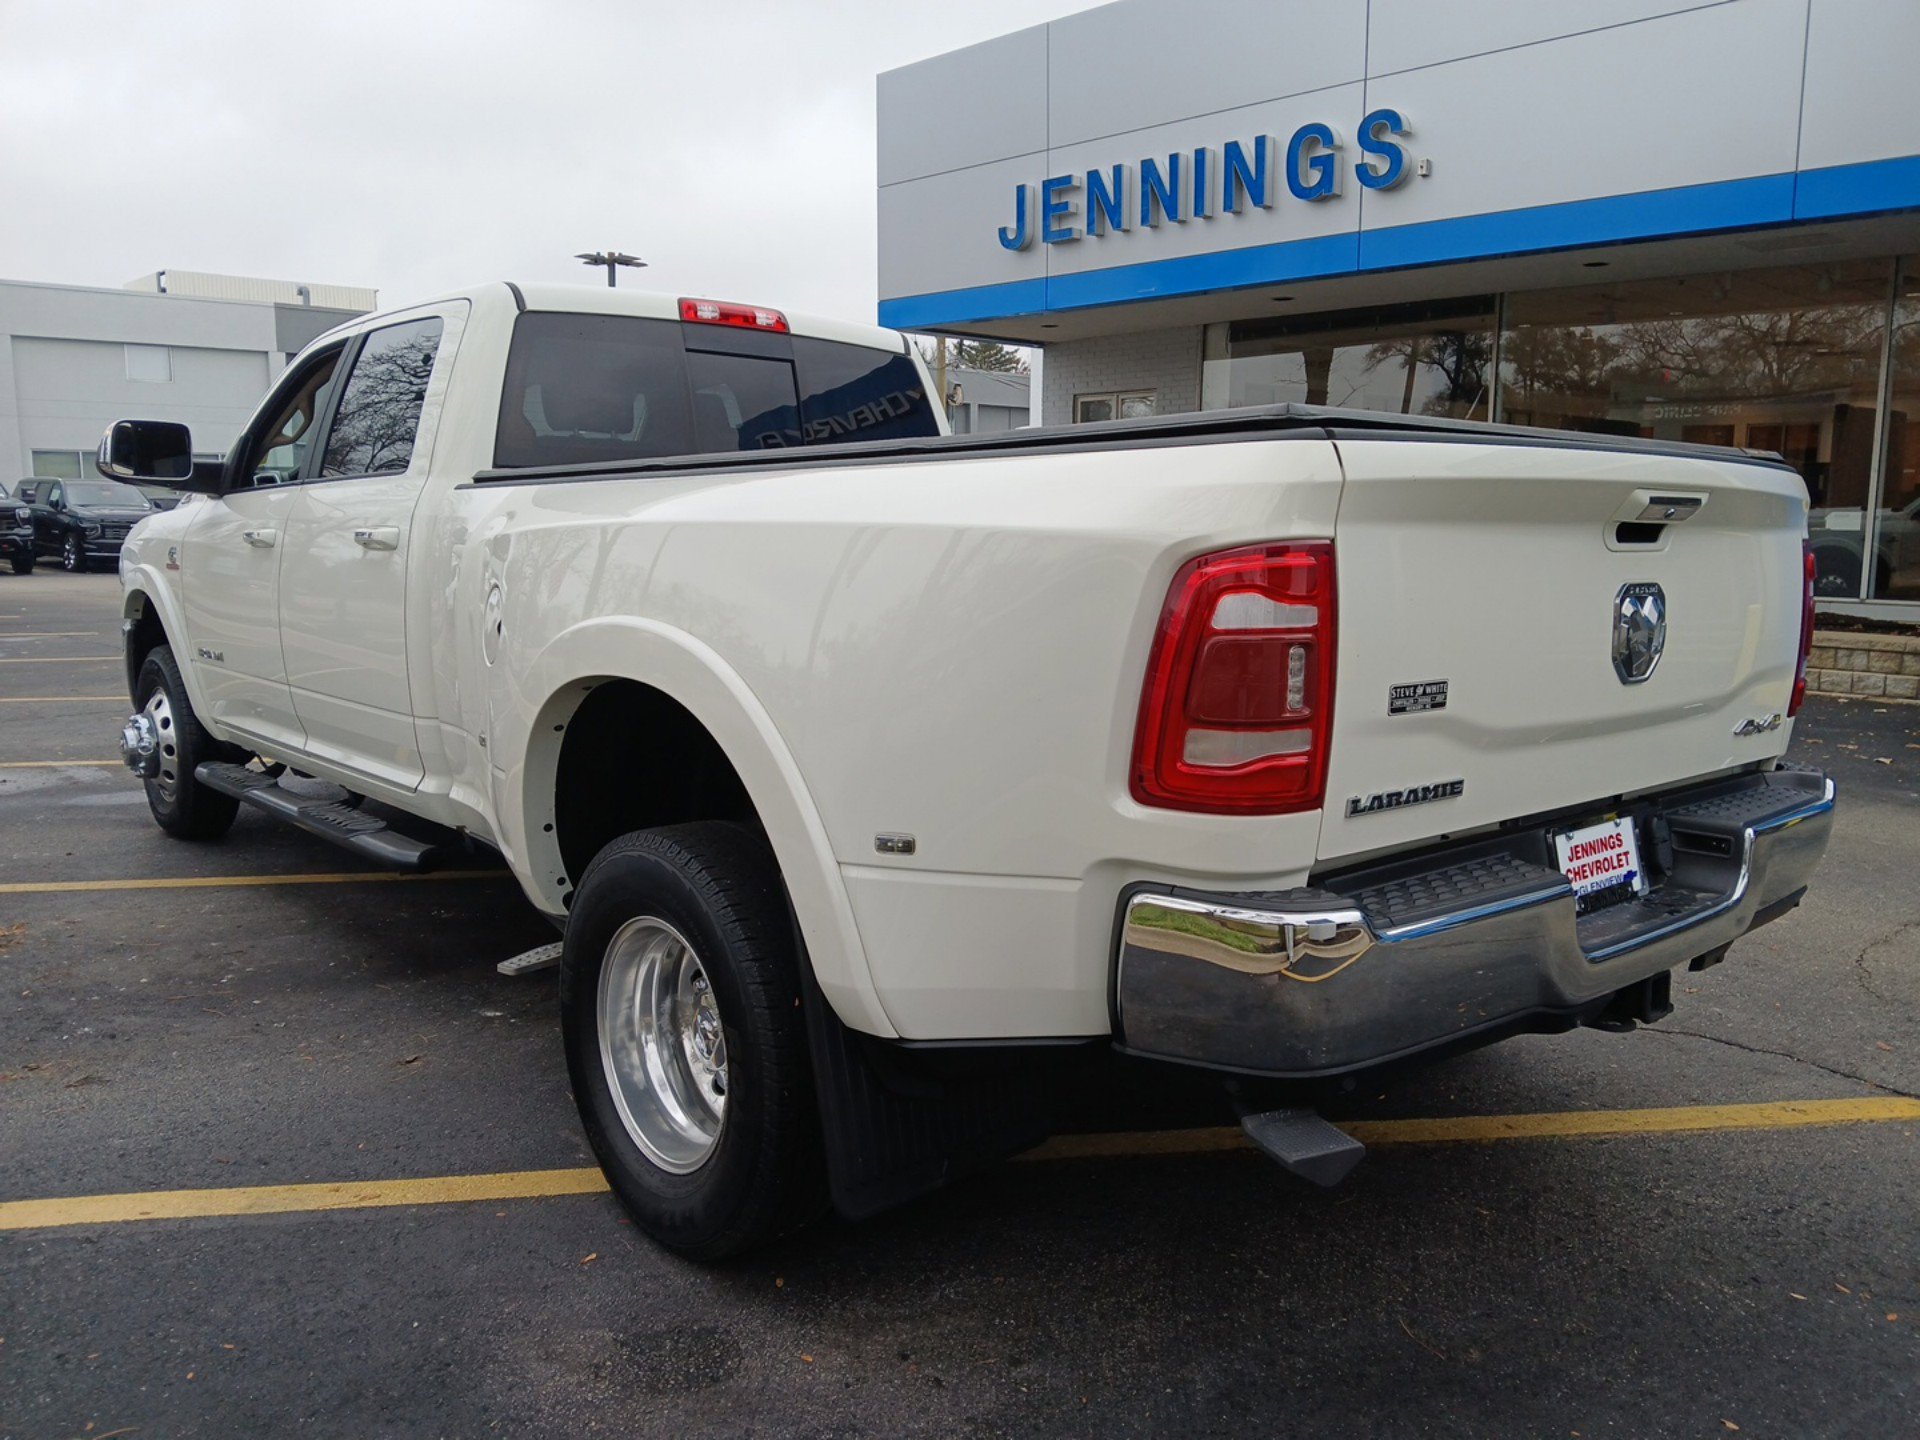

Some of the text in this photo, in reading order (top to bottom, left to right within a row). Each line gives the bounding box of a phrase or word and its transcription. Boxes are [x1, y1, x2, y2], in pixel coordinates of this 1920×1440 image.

[998, 109, 1412, 251] JENNINGS
[1391, 683, 1448, 698] STEVE WHITE
[1346, 777, 1464, 816] LARAMIE
[1567, 832, 1624, 863] JENNINGS
[1566, 851, 1630, 883] CHEVROLET
